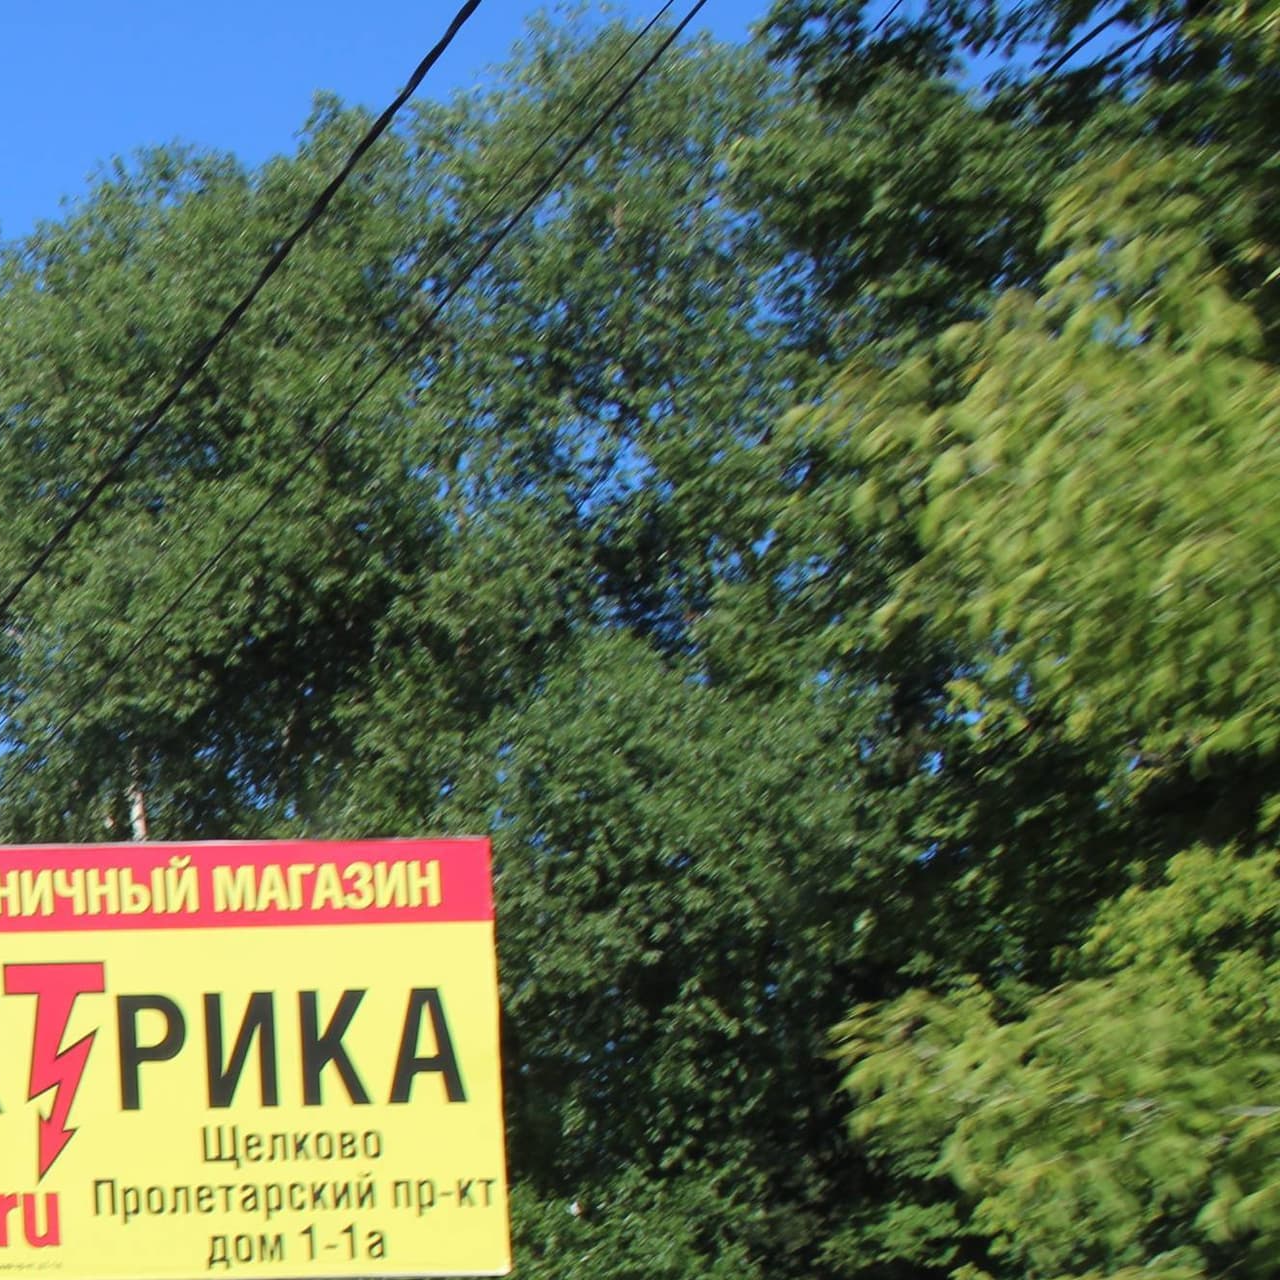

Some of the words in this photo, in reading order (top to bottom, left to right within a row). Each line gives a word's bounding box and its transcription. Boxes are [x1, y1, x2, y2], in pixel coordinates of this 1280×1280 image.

[212, 860, 442, 913] МАГАЗИН
[201, 1124, 384, 1169] Щелково
[92, 1172, 378, 1224] Пролетарский
[392, 1176, 498, 1217] пр-кт
[207, 1232, 285, 1270] дом
[297, 1222, 388, 1262] 1-1а
